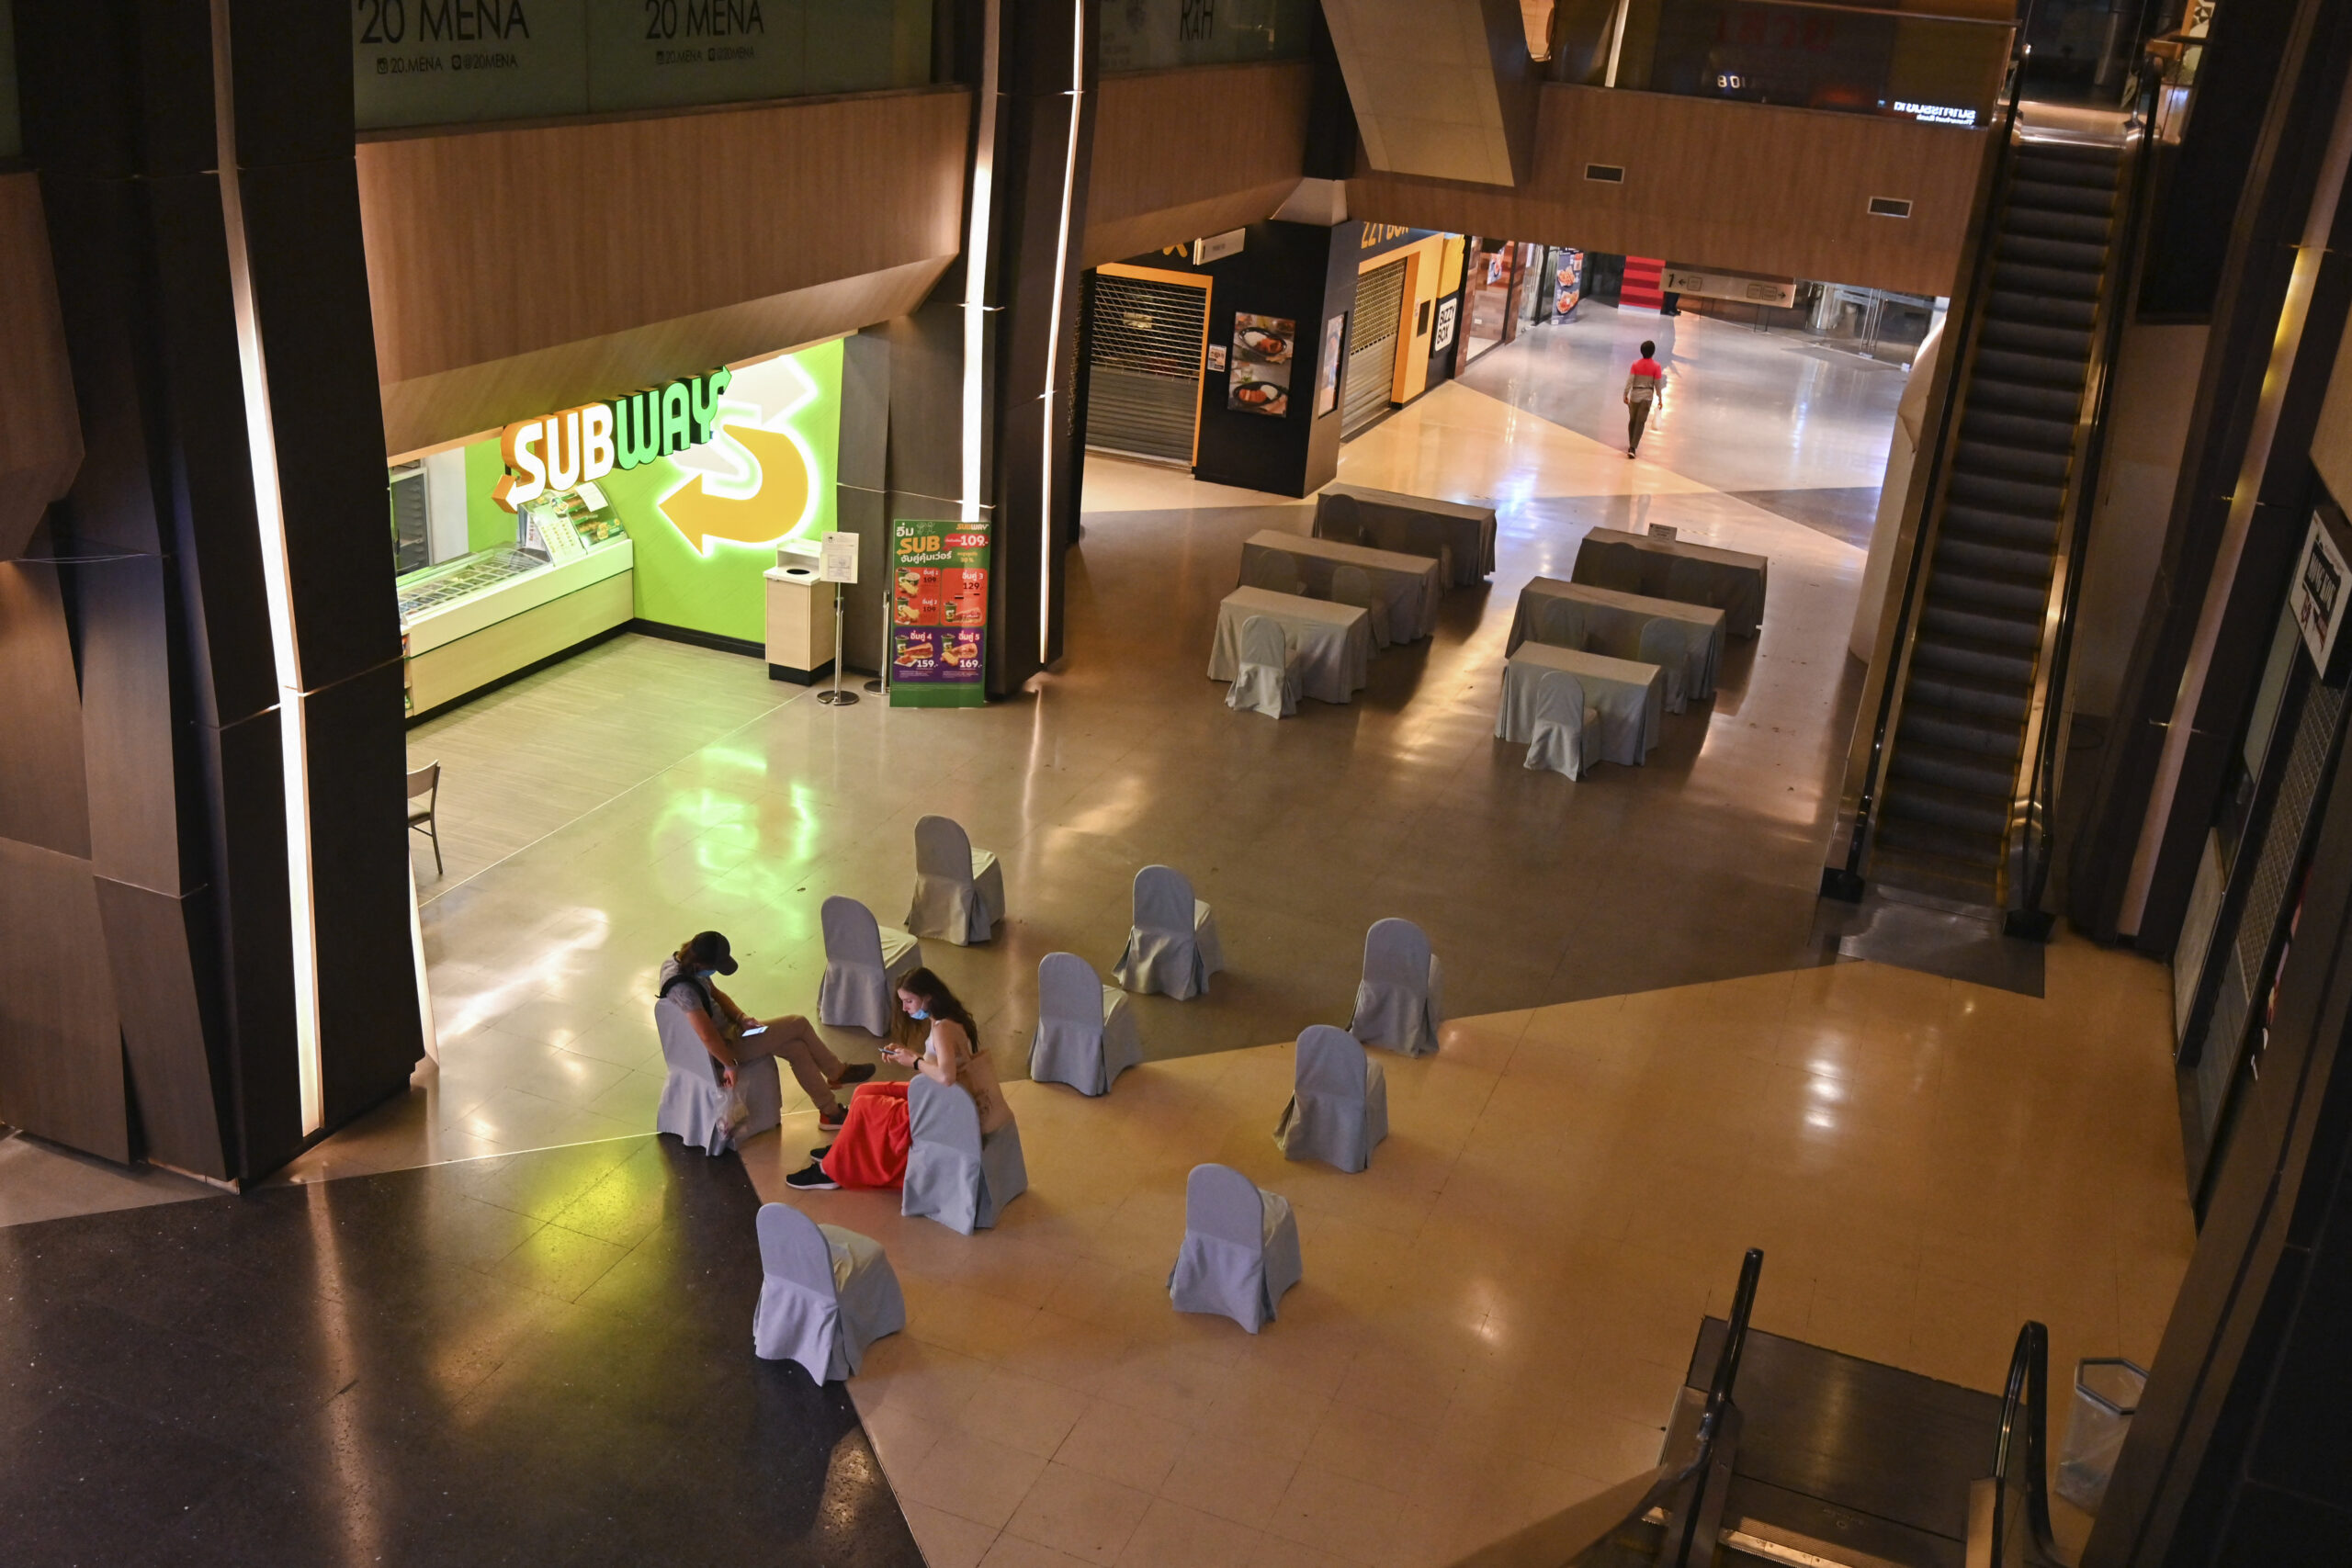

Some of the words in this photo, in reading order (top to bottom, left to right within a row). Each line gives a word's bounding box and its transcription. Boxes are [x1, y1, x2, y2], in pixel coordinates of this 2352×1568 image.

[358, 0, 405, 44] 20
[419, 0, 530, 42] MENA
[645, 0, 677, 39] 20
[686, 0, 764, 38] MENA
[1439, 305, 1456, 327] BIZZY
[1436, 324, 1451, 345] BOX
[496, 365, 732, 513] SUBWAY
[896, 522, 914, 537] อิ่ม
[956, 523, 989, 531] SUBWAY
[897, 536, 941, 556] SUB
